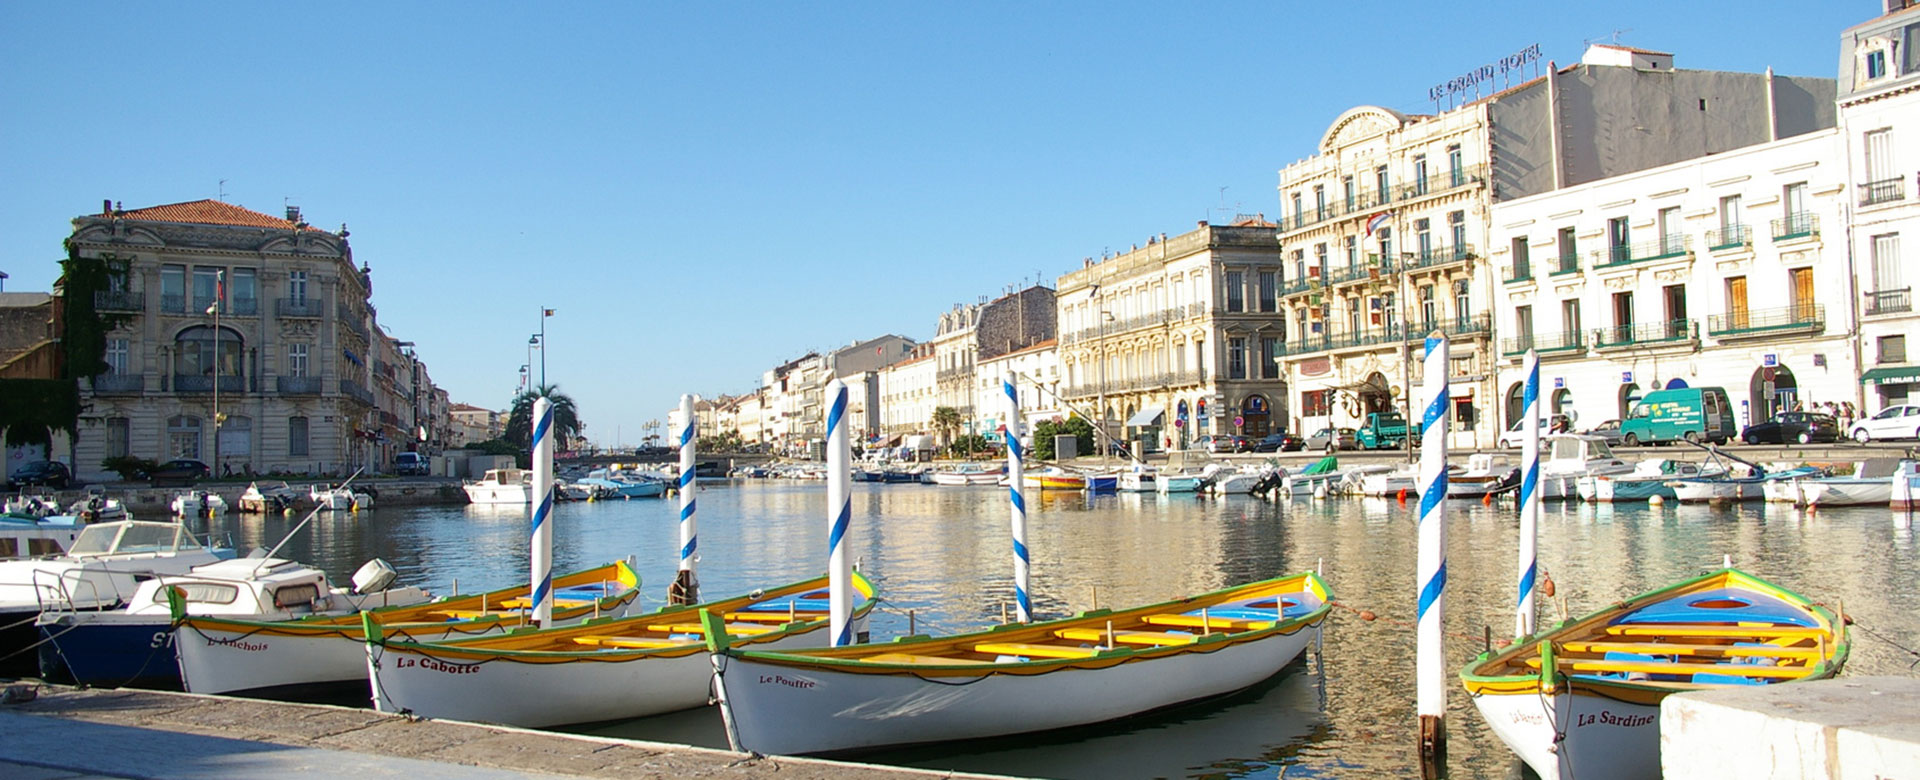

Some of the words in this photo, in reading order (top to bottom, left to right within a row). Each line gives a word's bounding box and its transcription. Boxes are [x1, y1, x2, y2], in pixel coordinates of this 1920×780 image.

[1429, 84, 1443, 101] LE
[1447, 65, 1494, 93] GRAND
[1499, 43, 1543, 73] HOTEL
[1891, 375, 1914, 384] PALAIS
[397, 657, 415, 668] La
[420, 658, 480, 674] Cabotte
[759, 675, 772, 684] Le
[775, 675, 815, 688] Pouffre
[1577, 713, 1595, 727] La
[1600, 711, 1654, 727] Sardine
